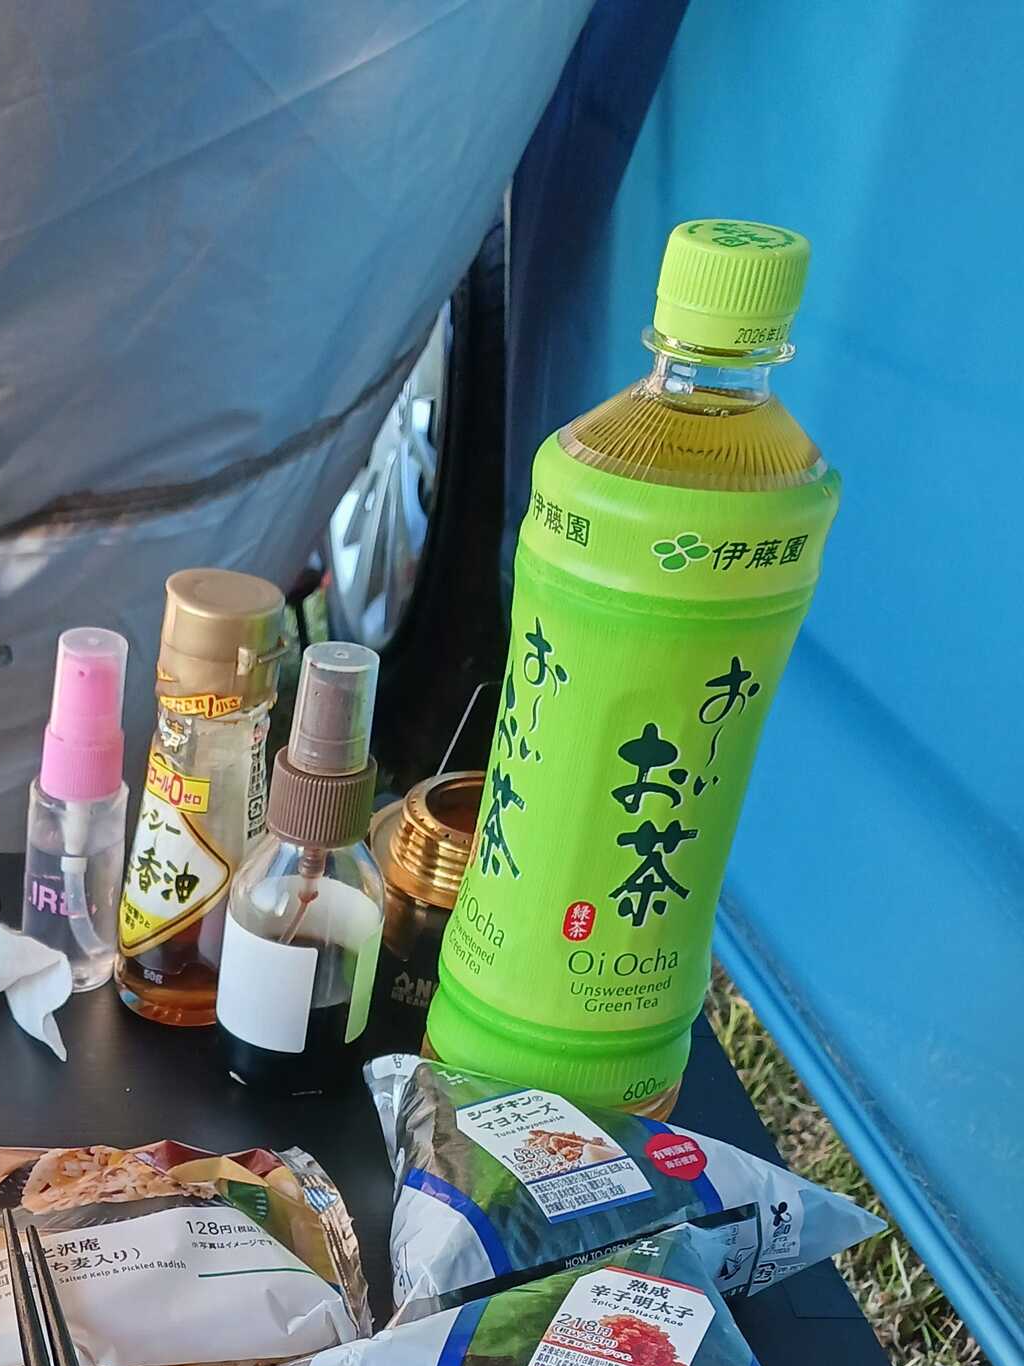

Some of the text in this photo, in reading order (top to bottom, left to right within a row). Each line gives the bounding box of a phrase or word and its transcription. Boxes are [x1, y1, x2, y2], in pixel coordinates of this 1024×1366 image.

[531, 492, 591, 547] 伊藤園
[711, 534, 808, 570] 伊藤園
[608, 722, 698, 927] お茶
[126, 847, 200, 904] 香油
[466, 896, 505, 949] Ocha
[568, 903, 592, 939] 緑茶
[568, 947, 679, 976] Oi Ocha
[570, 976, 672, 997] Unsweetened
[584, 996, 659, 1013] Green Tea
[477, 1102, 559, 1131] マヨネーズ
[493, 1130, 515, 1139] Tuna
[59, 1274, 88, 1285] Salted
[90, 1269, 111, 1280] Kelp
[121, 1262, 155, 1273] Pickled
[157, 1259, 187, 1271] Radish
[565, 1255, 590, 1269] HOW
[590, 1285, 694, 1319] 辛子明太子
[627, 1279, 671, 1299] 熟成
[556, 1313, 613, 1338] 218円
[591, 1298, 684, 1327] Spicy Pollack Roe
